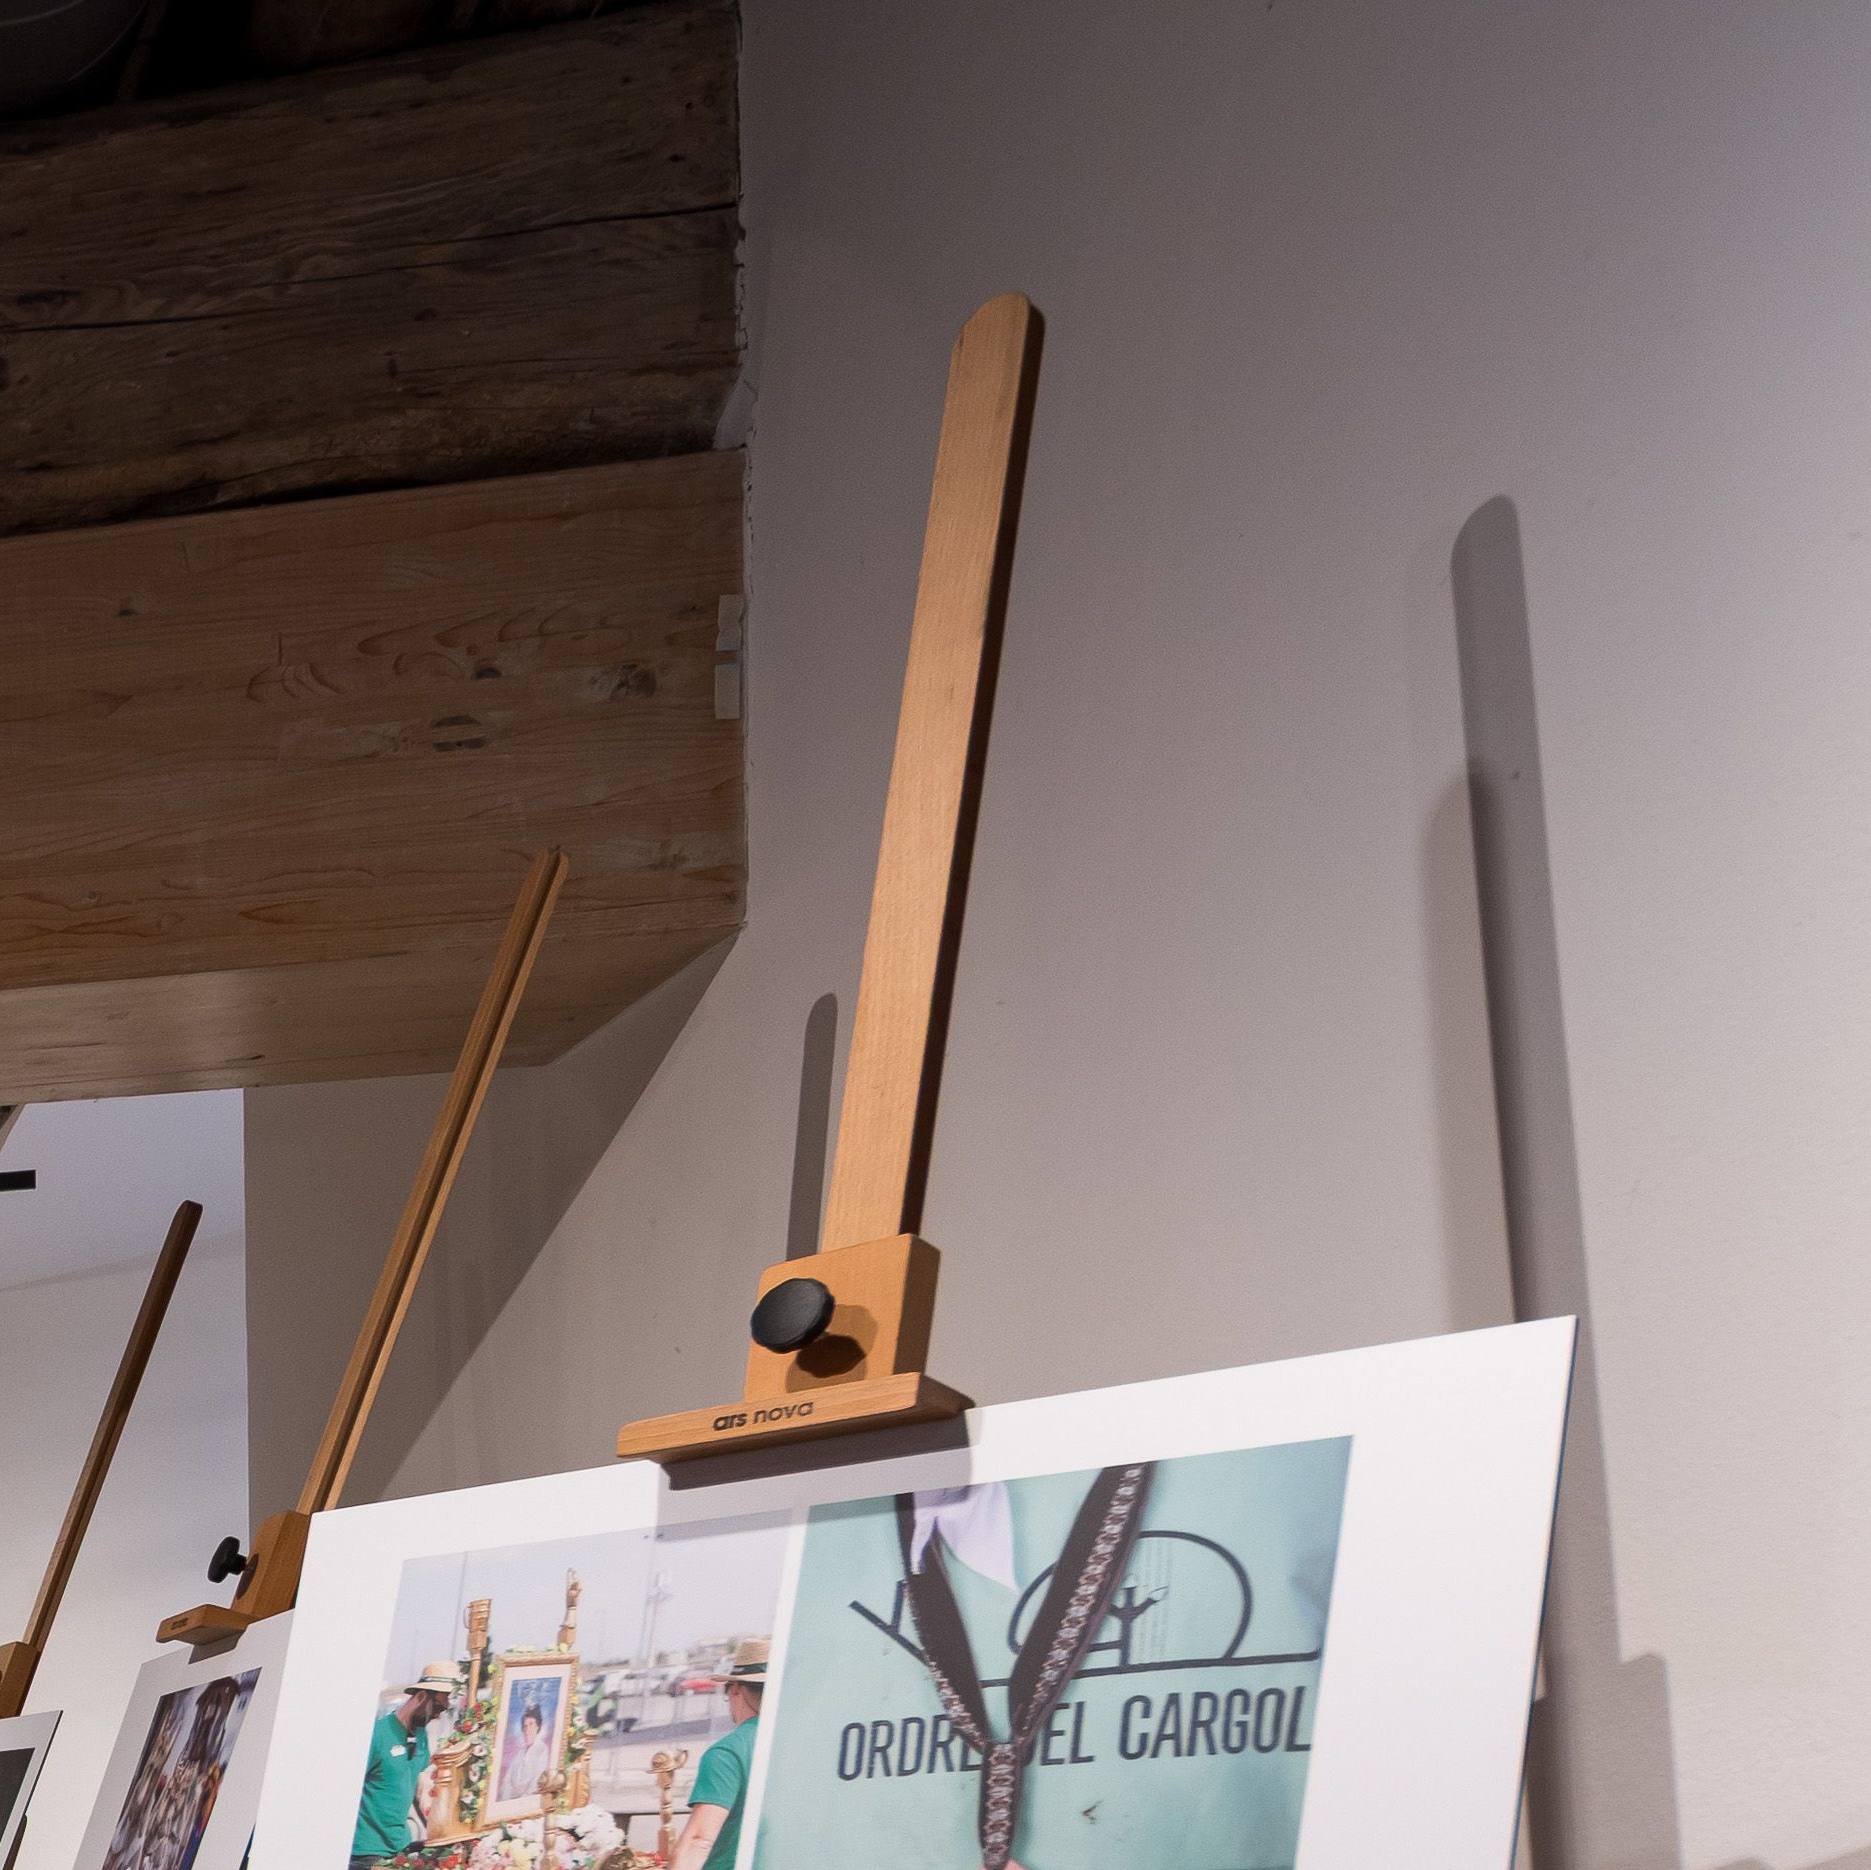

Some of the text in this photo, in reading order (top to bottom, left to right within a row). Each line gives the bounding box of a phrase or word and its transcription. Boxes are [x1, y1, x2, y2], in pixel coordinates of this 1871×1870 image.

[712, 1401, 814, 1432] ars nova
[1021, 1700, 1096, 1768] EL
[1118, 1685, 1312, 1761] CARGOL
